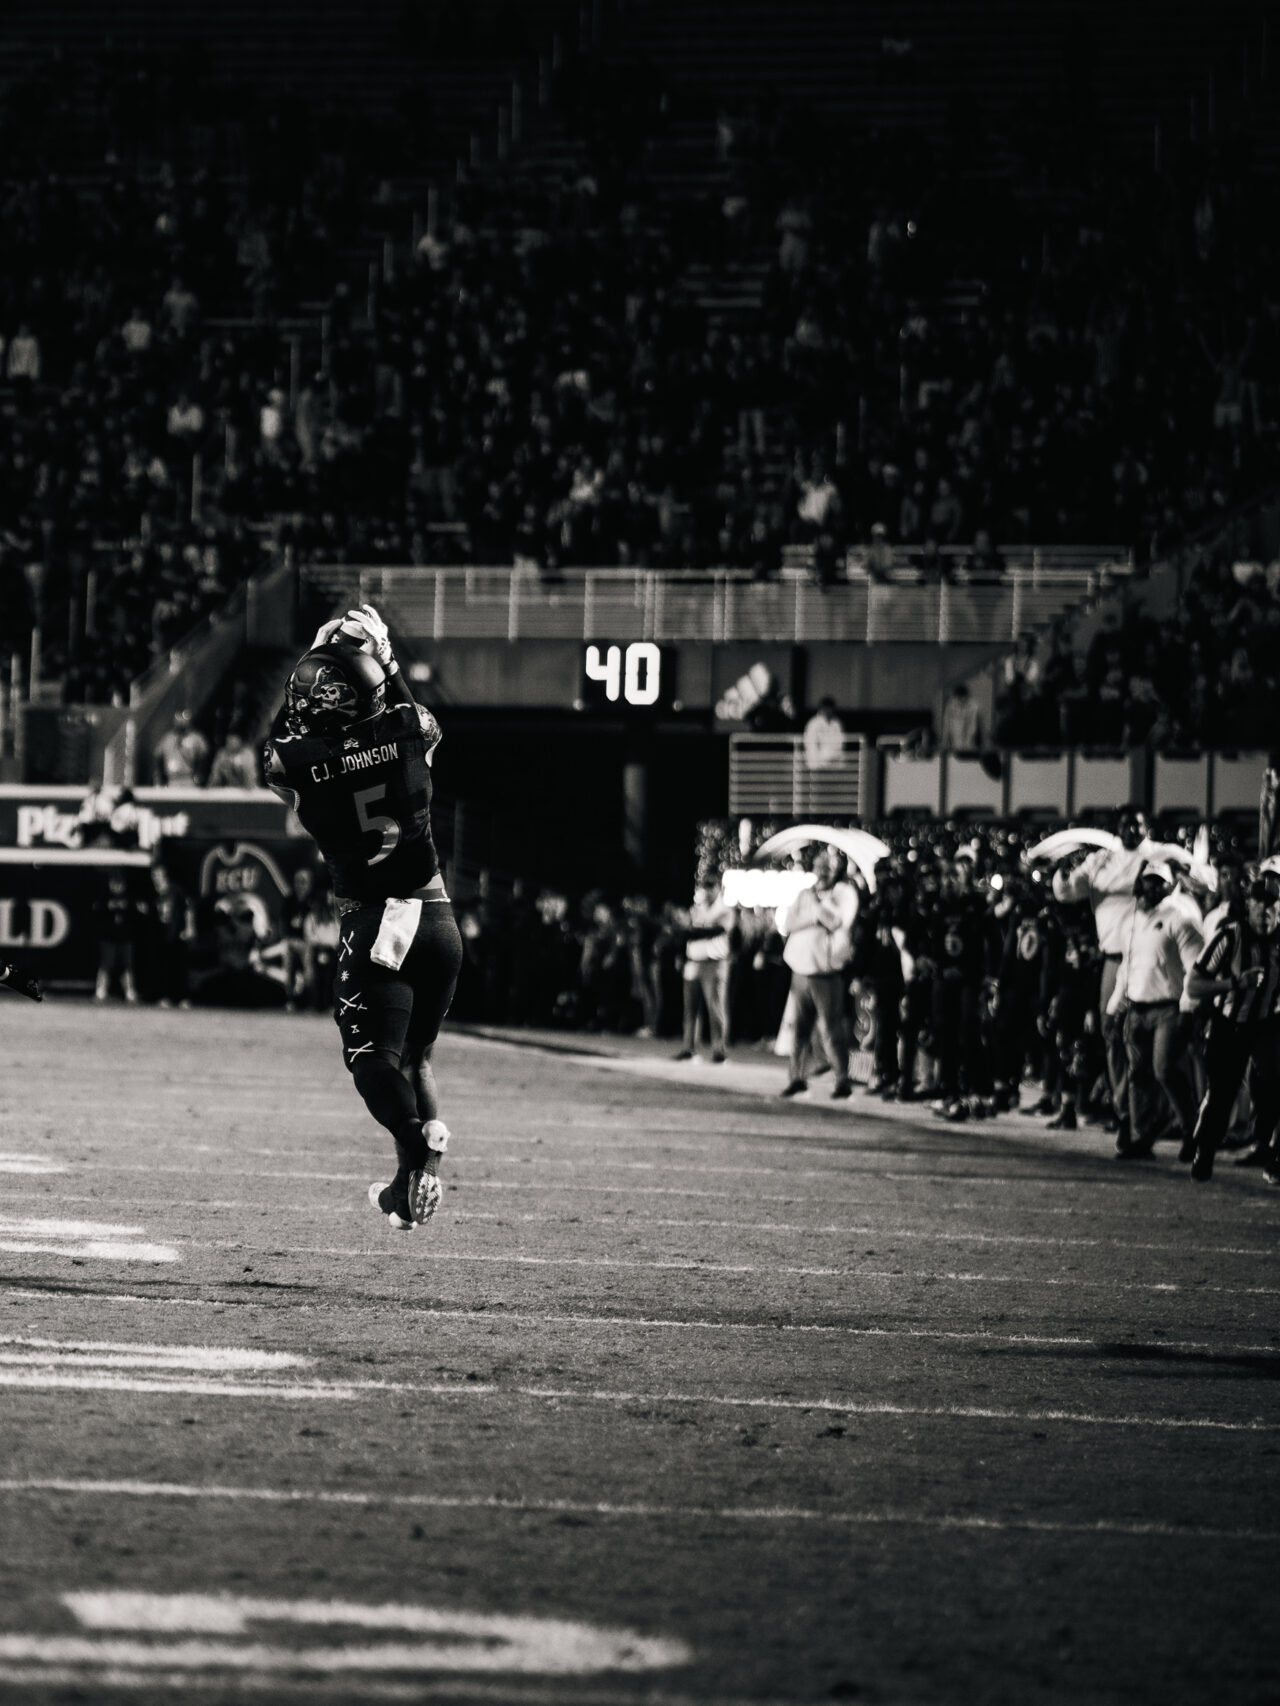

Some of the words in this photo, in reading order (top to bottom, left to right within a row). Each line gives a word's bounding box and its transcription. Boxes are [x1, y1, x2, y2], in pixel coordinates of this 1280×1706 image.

[585, 642, 661, 706] 40
[339, 742, 399, 775] JOHNSON
[353, 783, 402, 866] 5
